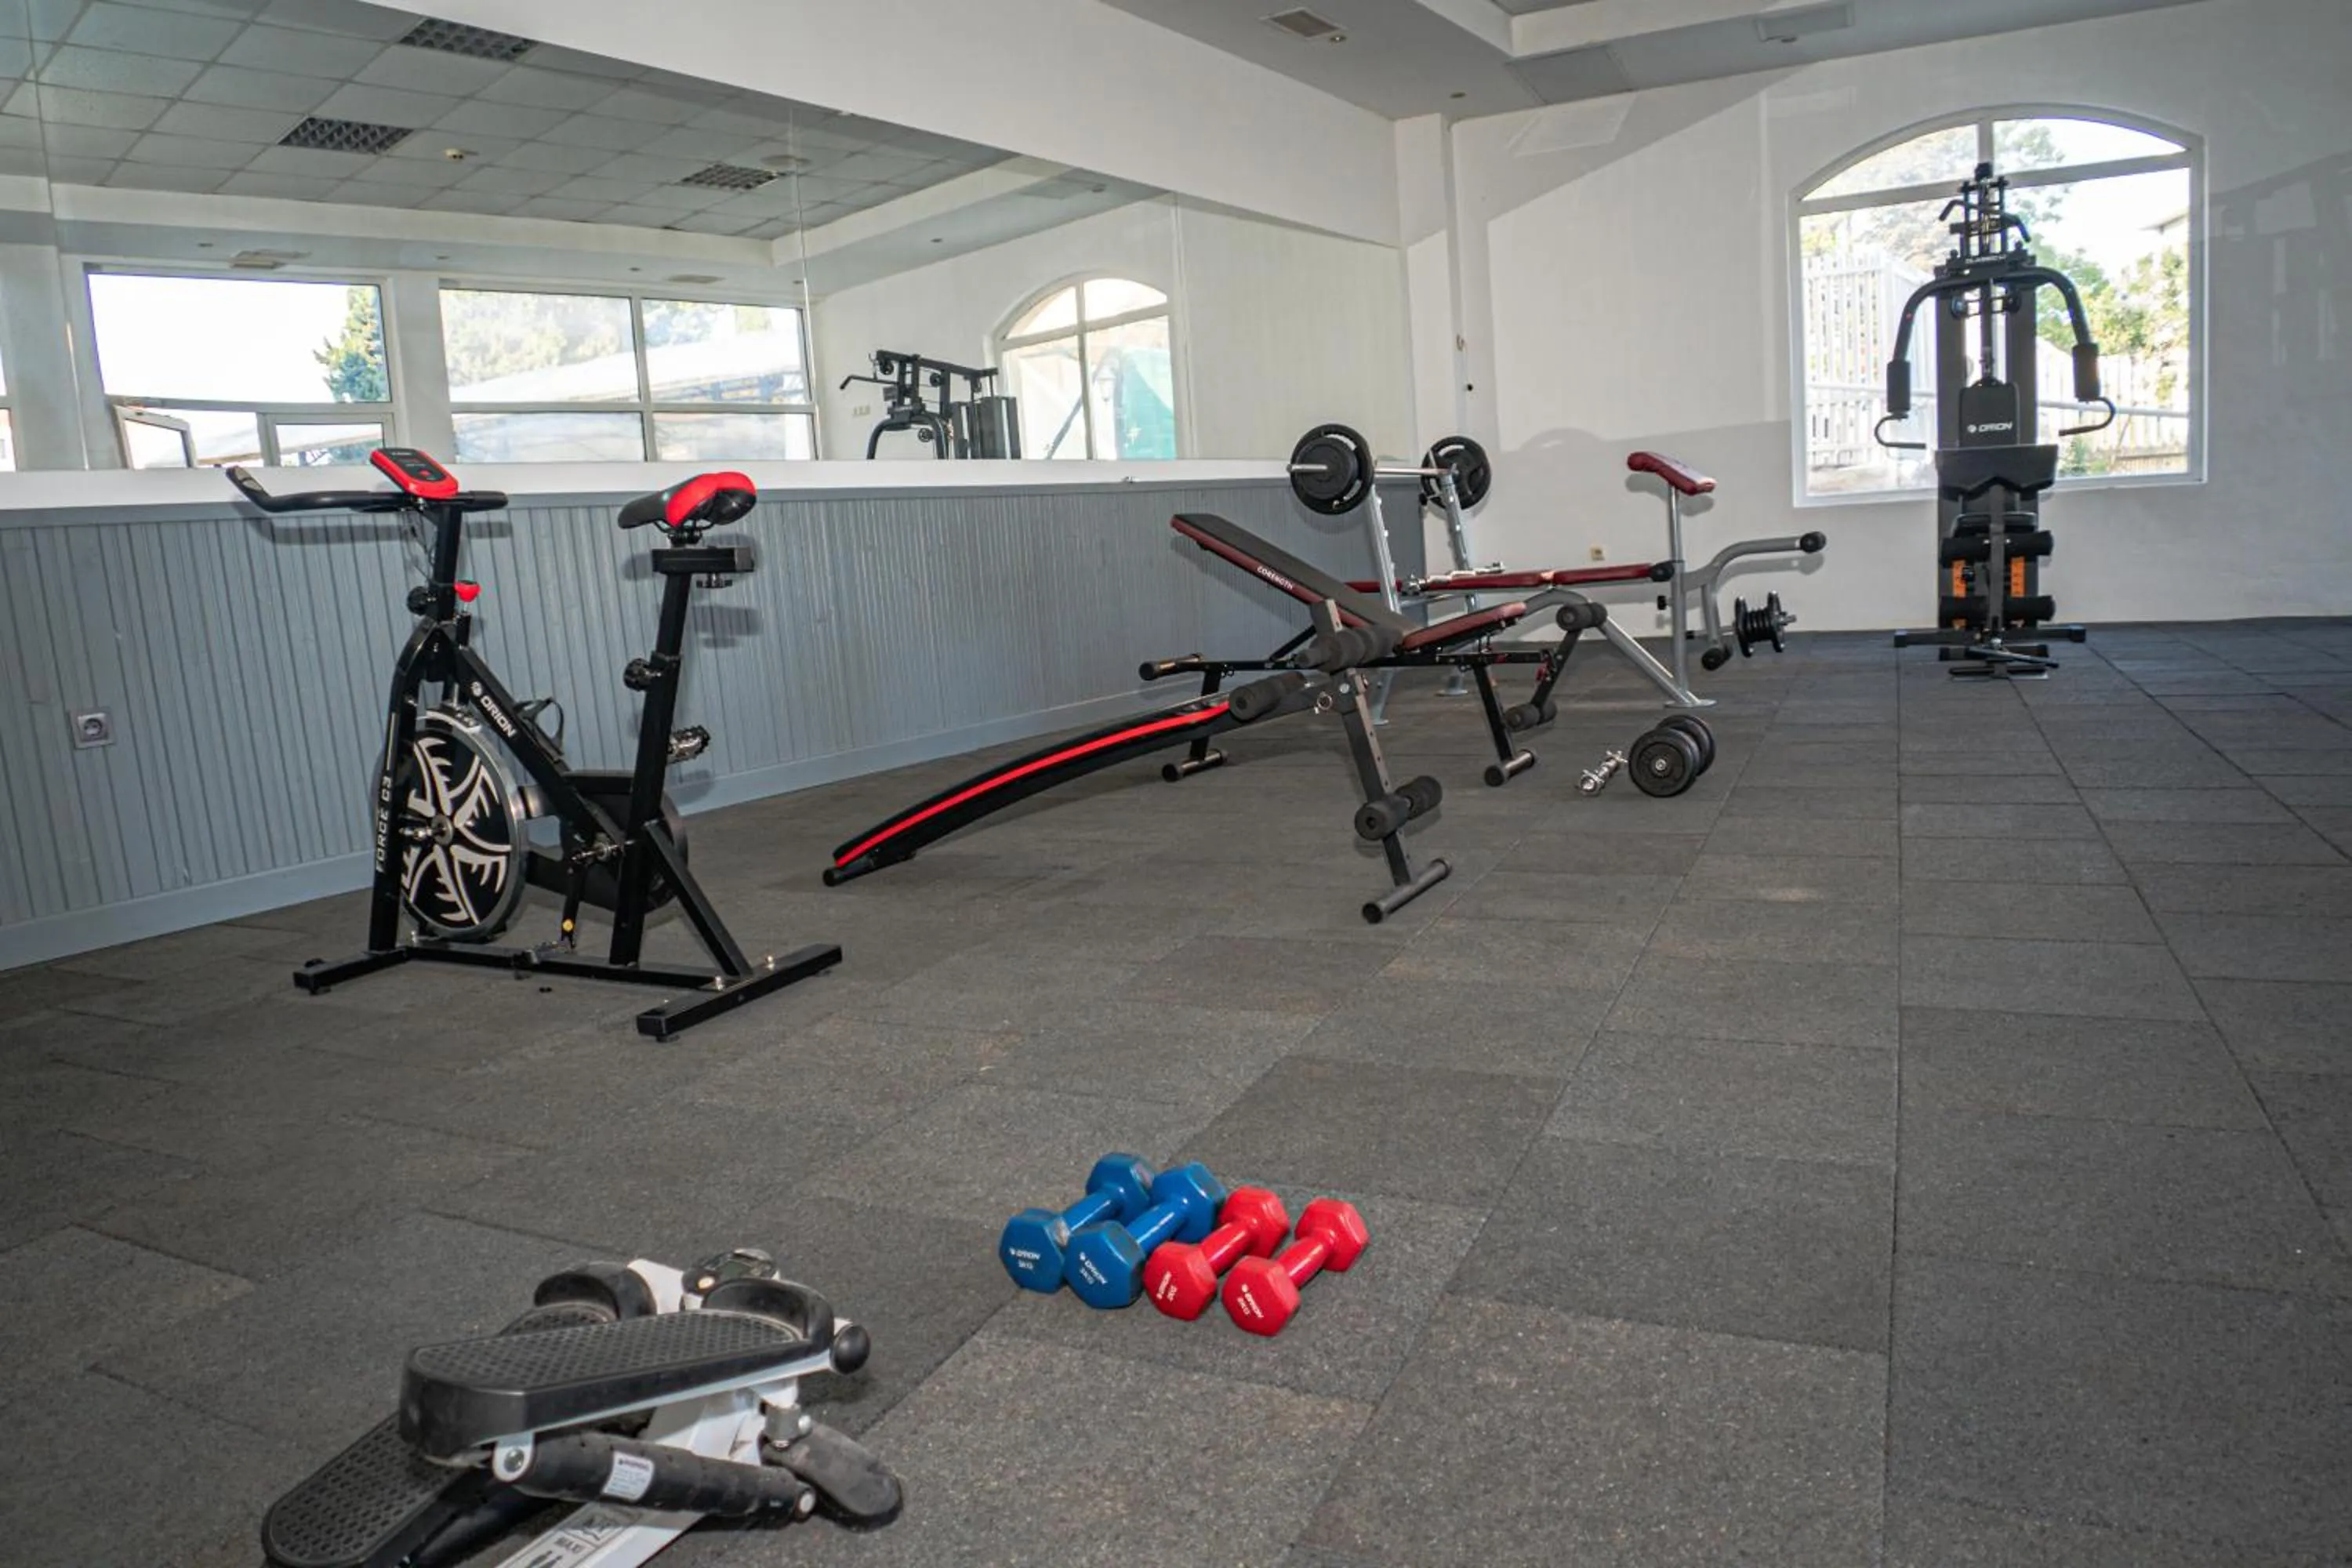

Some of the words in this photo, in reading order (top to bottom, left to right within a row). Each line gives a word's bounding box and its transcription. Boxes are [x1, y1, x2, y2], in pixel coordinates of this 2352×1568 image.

[1979, 421, 2013, 432] ORION
[481, 695, 517, 737] ORION
[376, 808, 389, 873] FORCE
[1016, 1249, 1040, 1260] ORION
[1084, 1259, 1108, 1284] ORION
